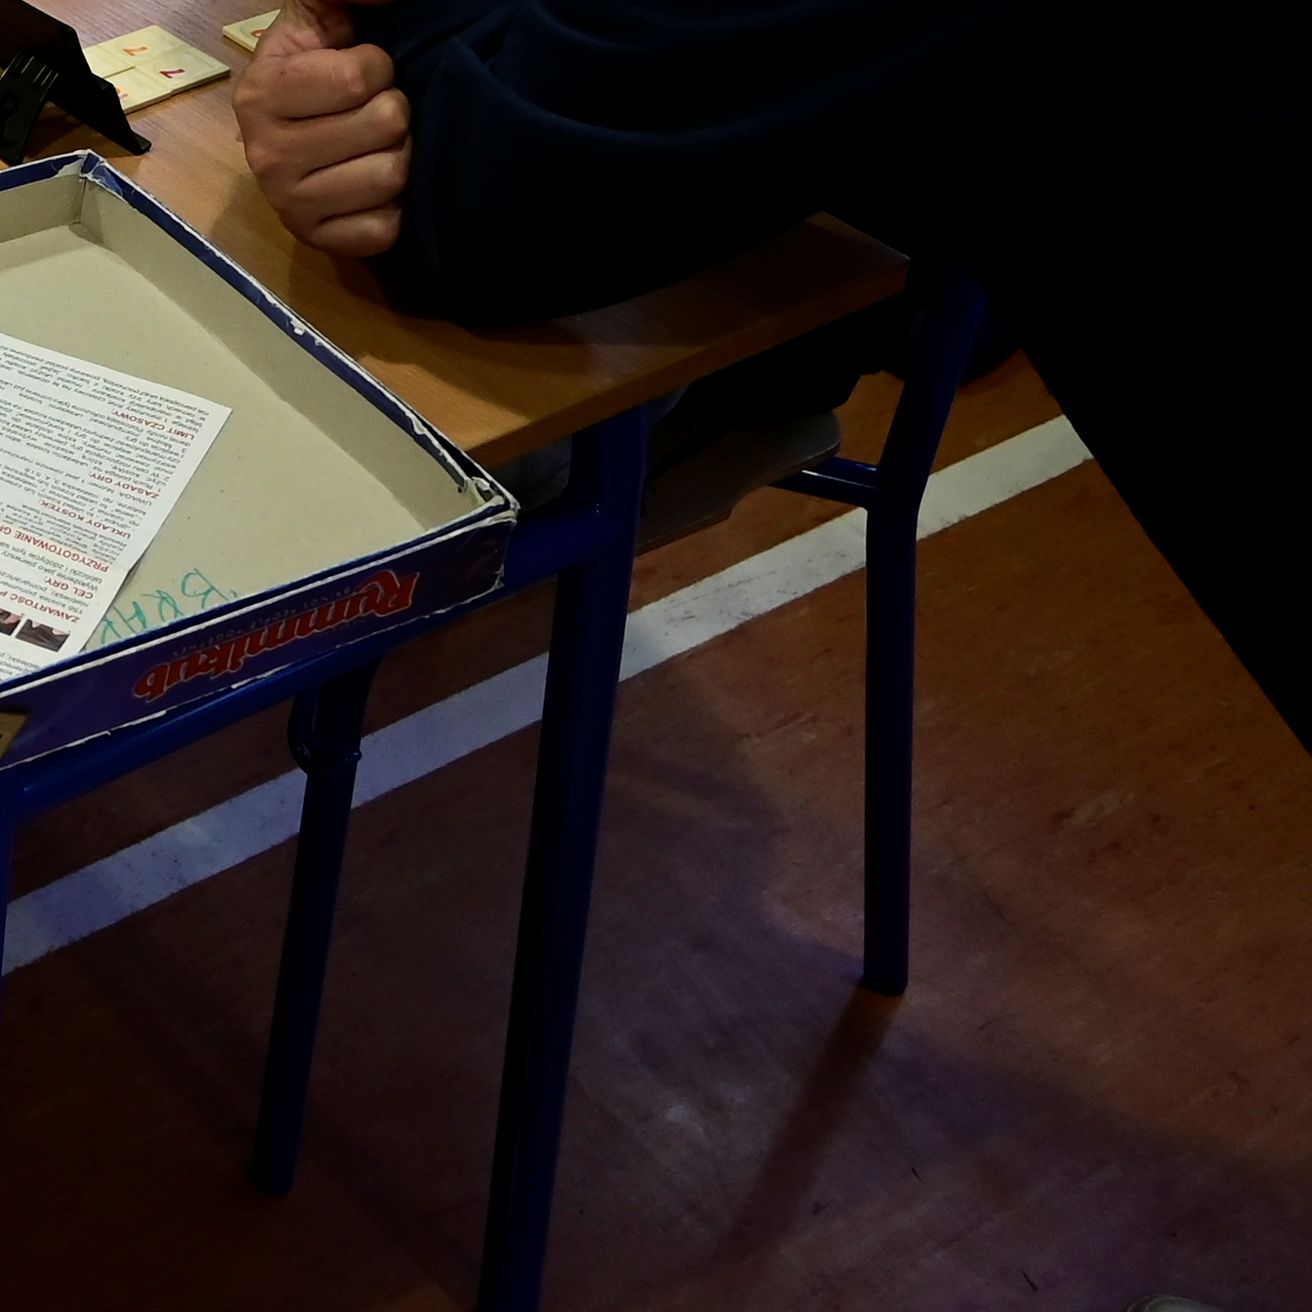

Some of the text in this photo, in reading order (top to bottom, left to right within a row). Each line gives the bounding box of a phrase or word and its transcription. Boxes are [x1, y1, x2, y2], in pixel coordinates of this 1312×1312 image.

[166, 427, 195, 440] LIMIT
[114, 480, 159, 499] ZASADY
[84, 517, 132, 539] UKŁADY
[12, 530, 110, 572] PRZYGOTOWANIE
[41, 575, 94, 599] CEL GRY:
[8, 592, 80, 623] ZAWARTOŚĆ
[131, 569, 421, 704] Rummikub
